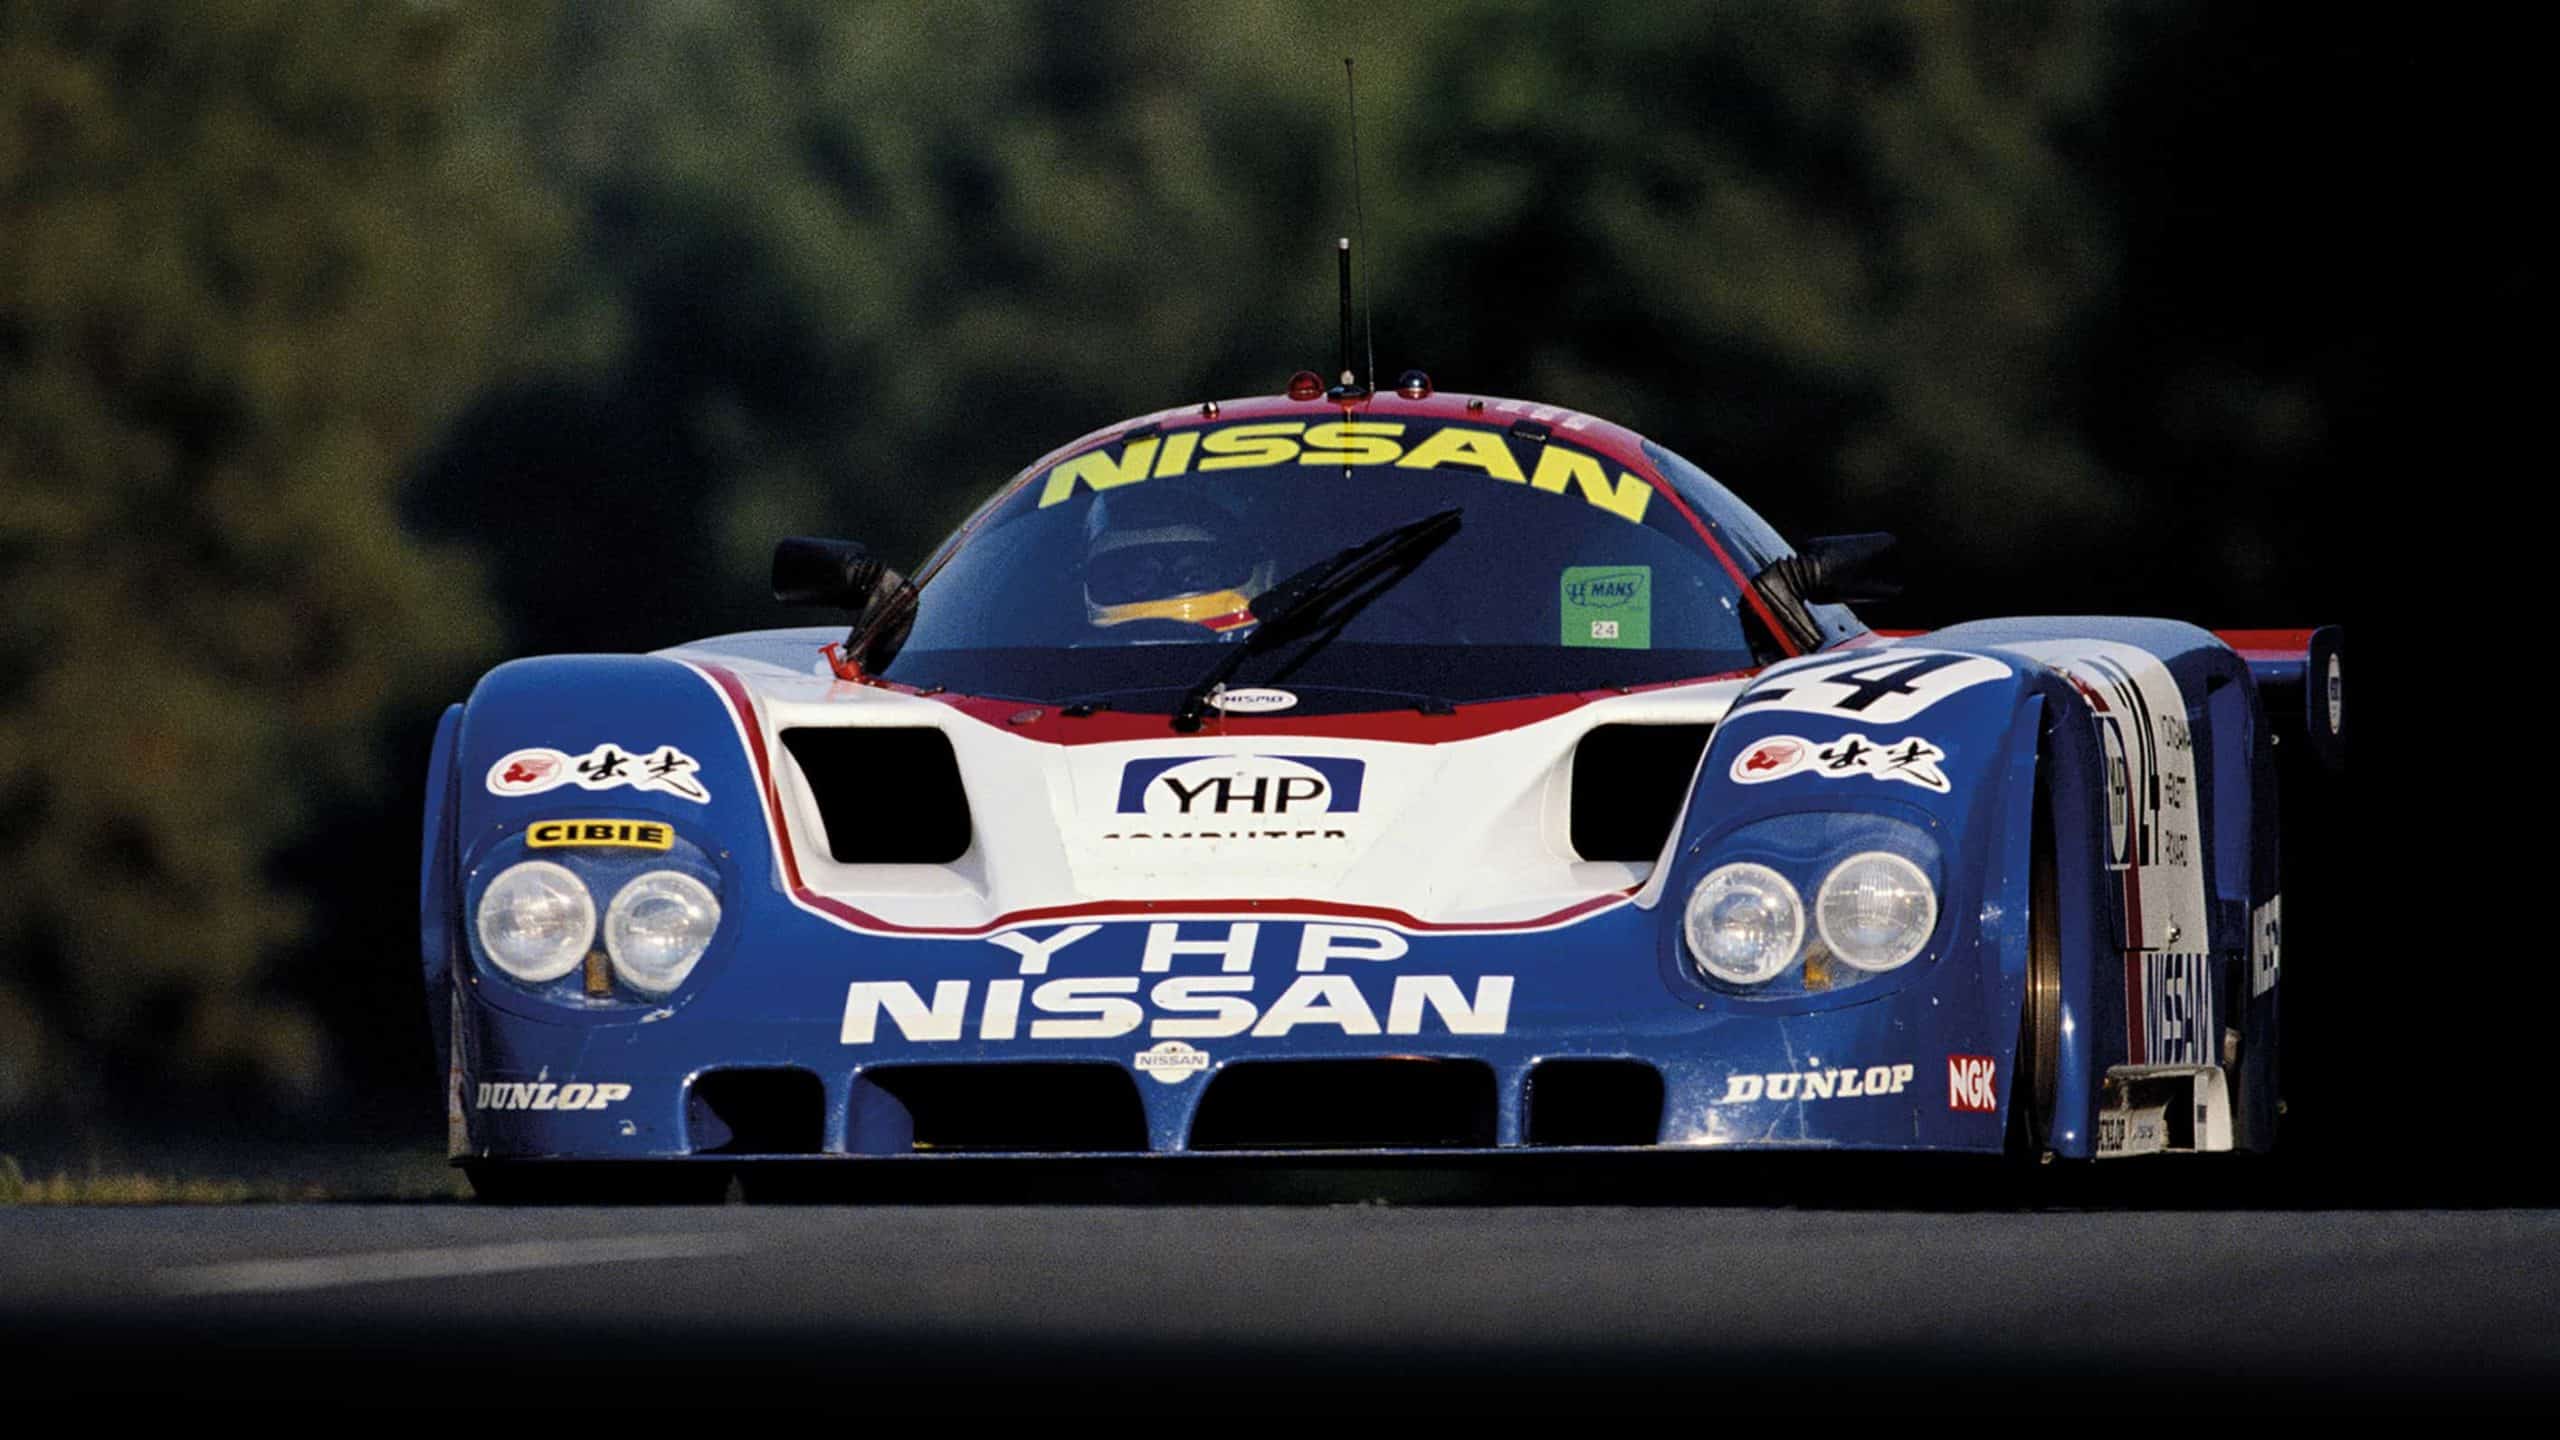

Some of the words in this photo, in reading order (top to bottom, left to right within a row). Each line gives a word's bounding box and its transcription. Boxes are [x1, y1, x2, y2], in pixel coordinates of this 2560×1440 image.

[1038, 421, 1653, 524] NISSAN
[1591, 581, 1634, 597] MANS
[1594, 623, 1615, 636] 24
[1160, 776, 1326, 814] YHP
[535, 825, 664, 844] CIBIE
[984, 921, 1410, 975] YHP
[840, 974, 1516, 1044] NISSAN
[2144, 952, 2211, 1066] NISSAN
[1139, 1054, 1205, 1066] NISSAN
[475, 1082, 634, 1111] DUNLOP
[1717, 1063, 1914, 1105] DUNLOP
[1949, 1057, 1997, 1111] NGK
